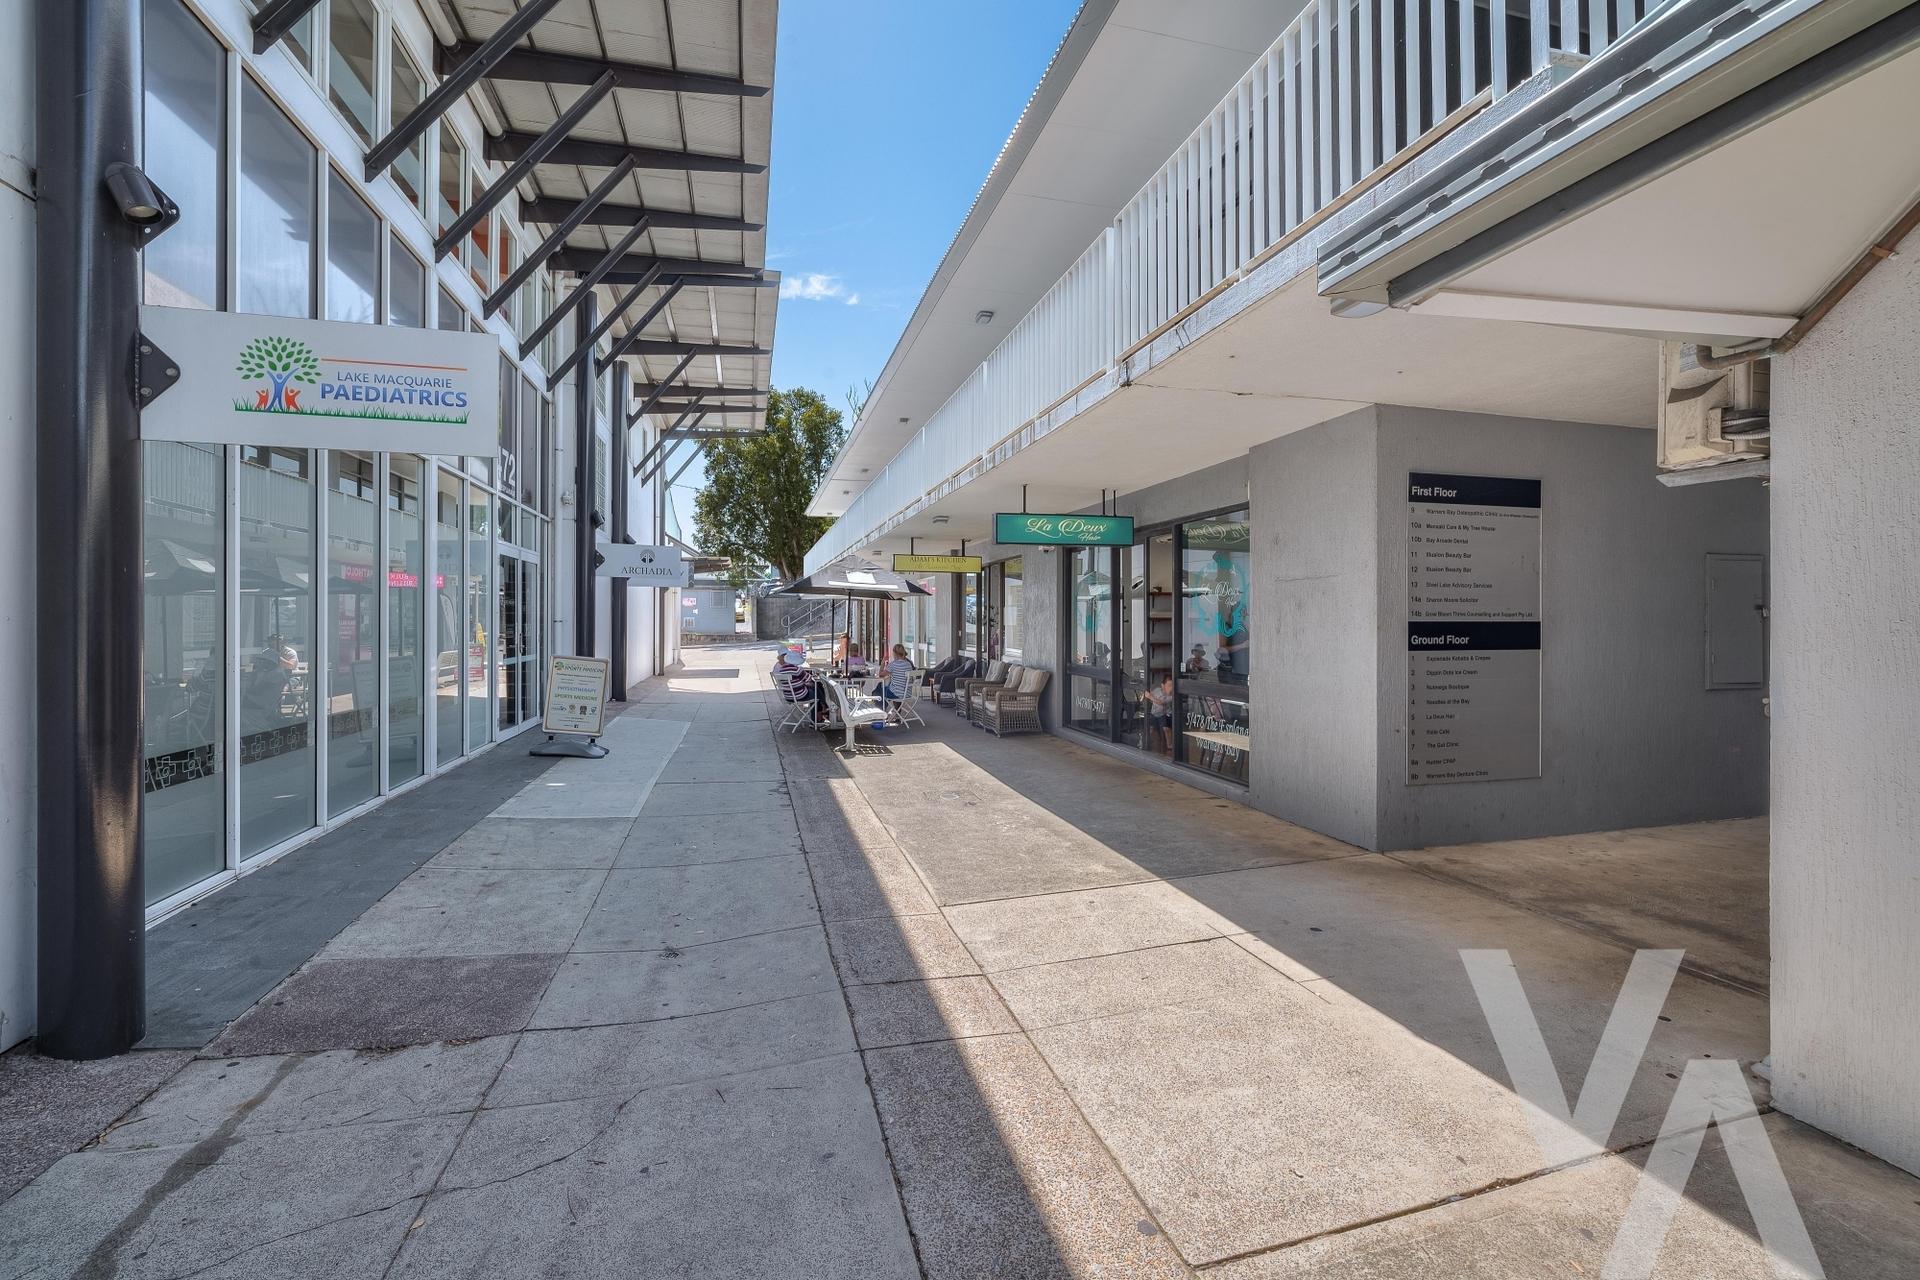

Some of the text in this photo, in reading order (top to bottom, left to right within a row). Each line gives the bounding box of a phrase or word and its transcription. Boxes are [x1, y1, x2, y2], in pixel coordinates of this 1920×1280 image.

[337, 371, 452, 389] LAKE MACQUARIE
[320, 382, 468, 408] PAEDIATRICS
[1411, 486, 1457, 497] First Floor
[1025, 518, 1108, 538] La Deux
[621, 566, 673, 576] ARCHADIA
[1411, 635, 1469, 645] Ground Floor
